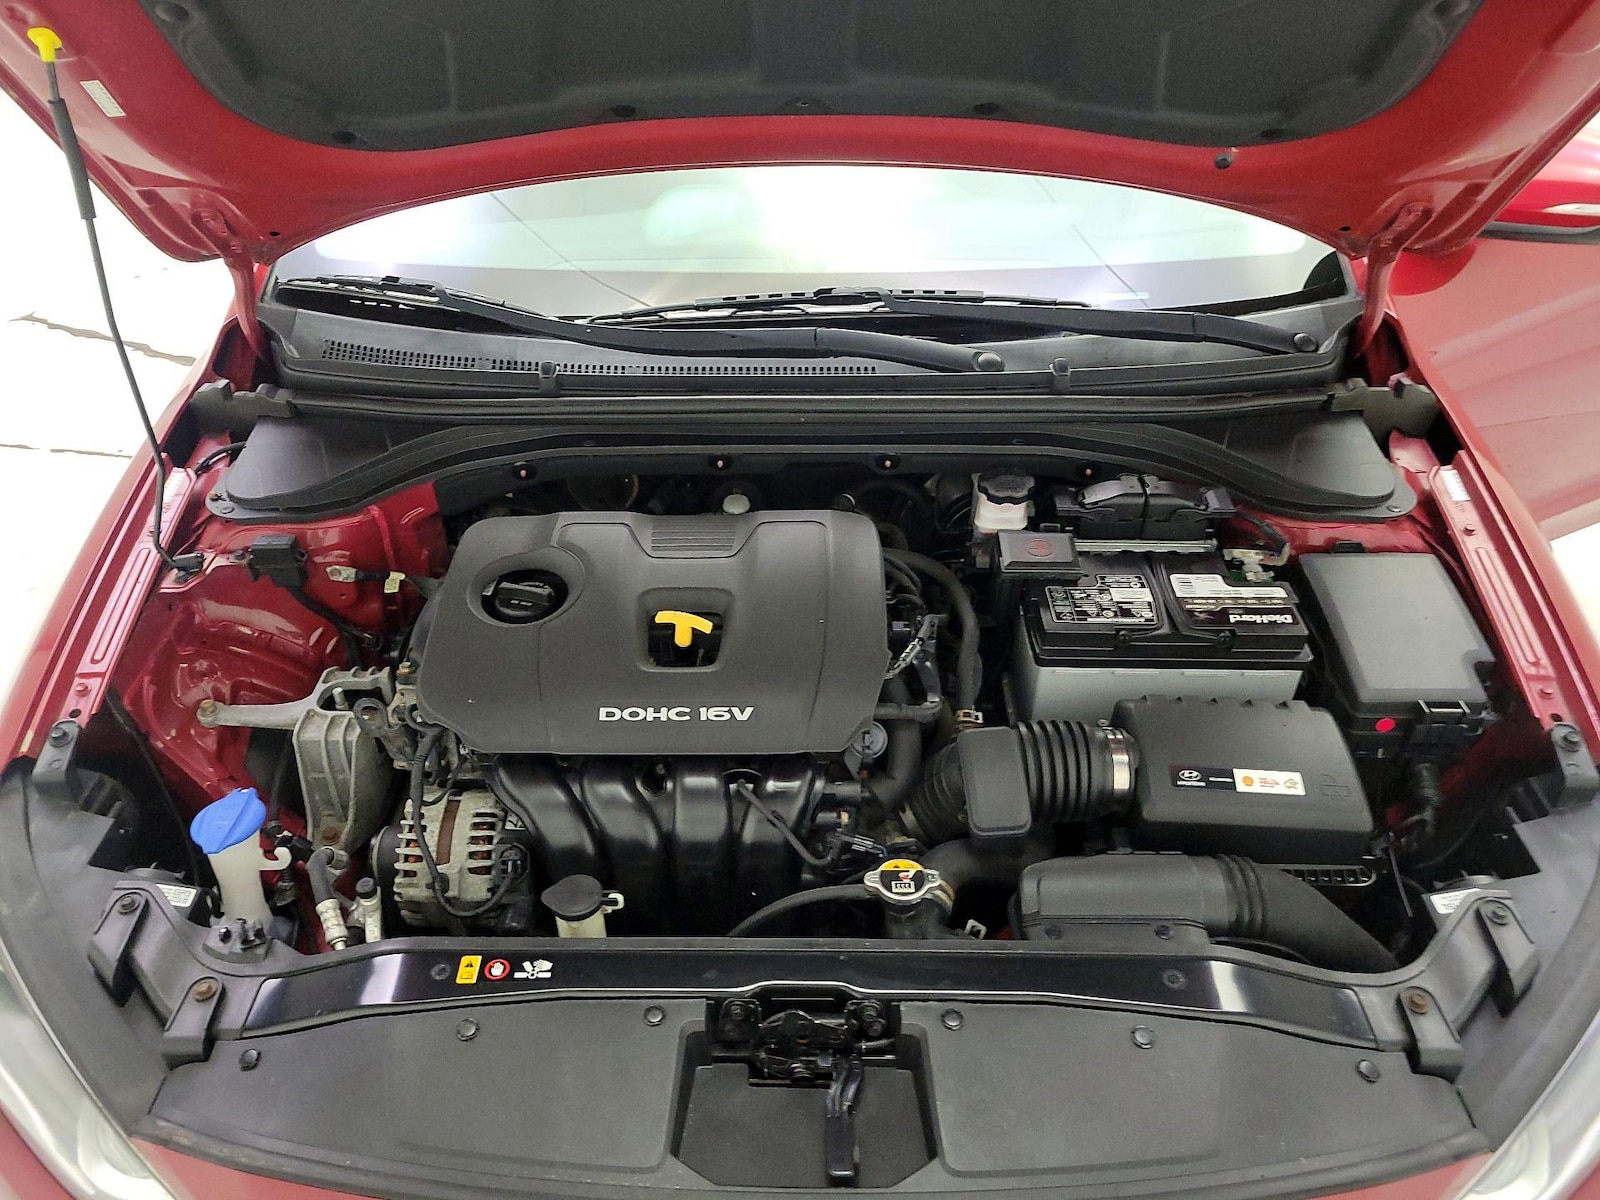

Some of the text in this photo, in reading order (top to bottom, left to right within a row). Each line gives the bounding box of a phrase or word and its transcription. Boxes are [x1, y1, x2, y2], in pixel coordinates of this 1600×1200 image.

[1228, 614, 1294, 624] DieHard
[599, 706, 755, 722] DOHC 16V
